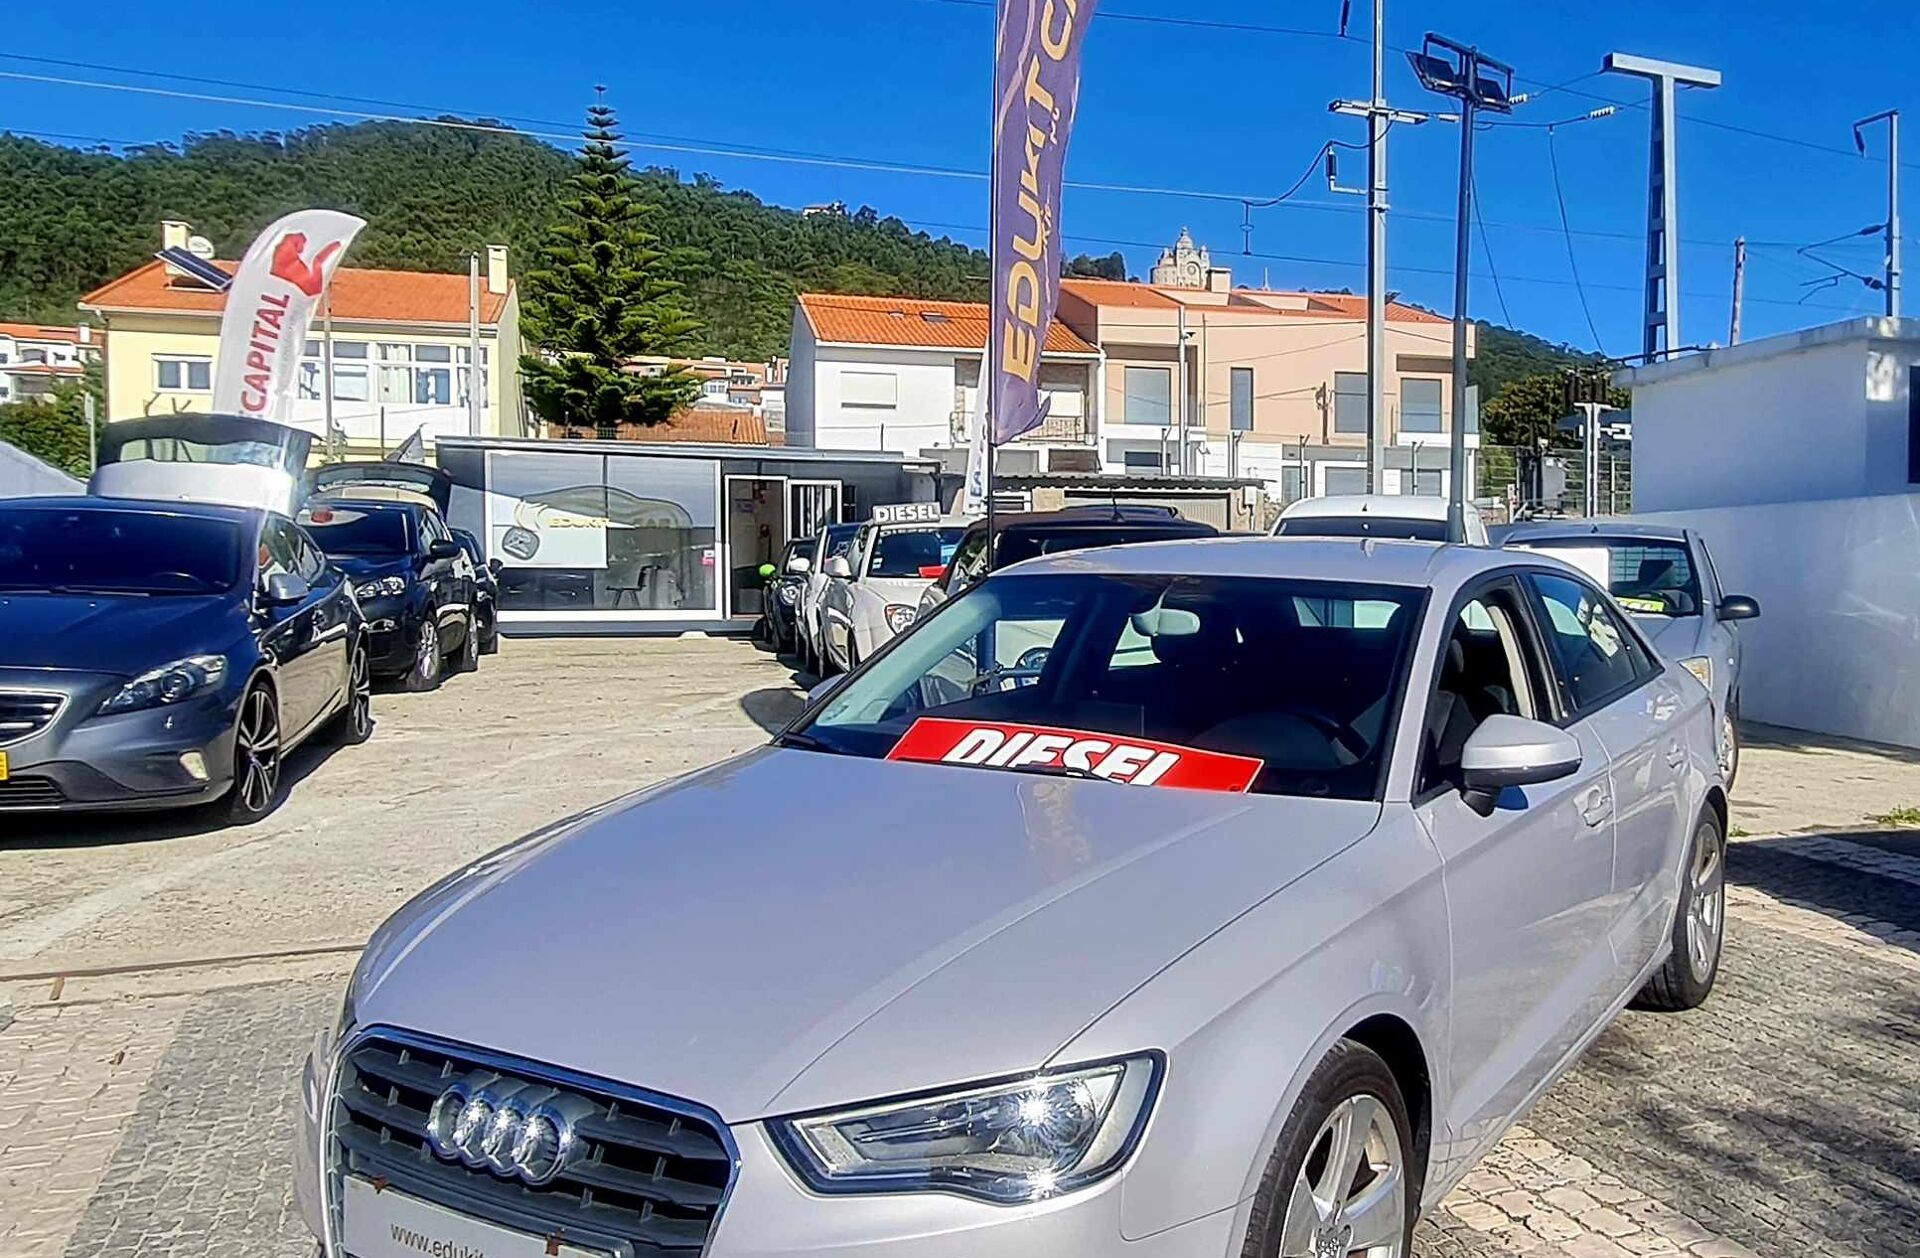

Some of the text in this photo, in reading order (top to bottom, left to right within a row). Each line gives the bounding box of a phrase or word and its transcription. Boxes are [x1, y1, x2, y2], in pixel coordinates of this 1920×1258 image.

[1003, 53, 1054, 382] EDUKIT
[241, 294, 290, 411] CAPITAL
[876, 505, 939, 522] DIESEL
